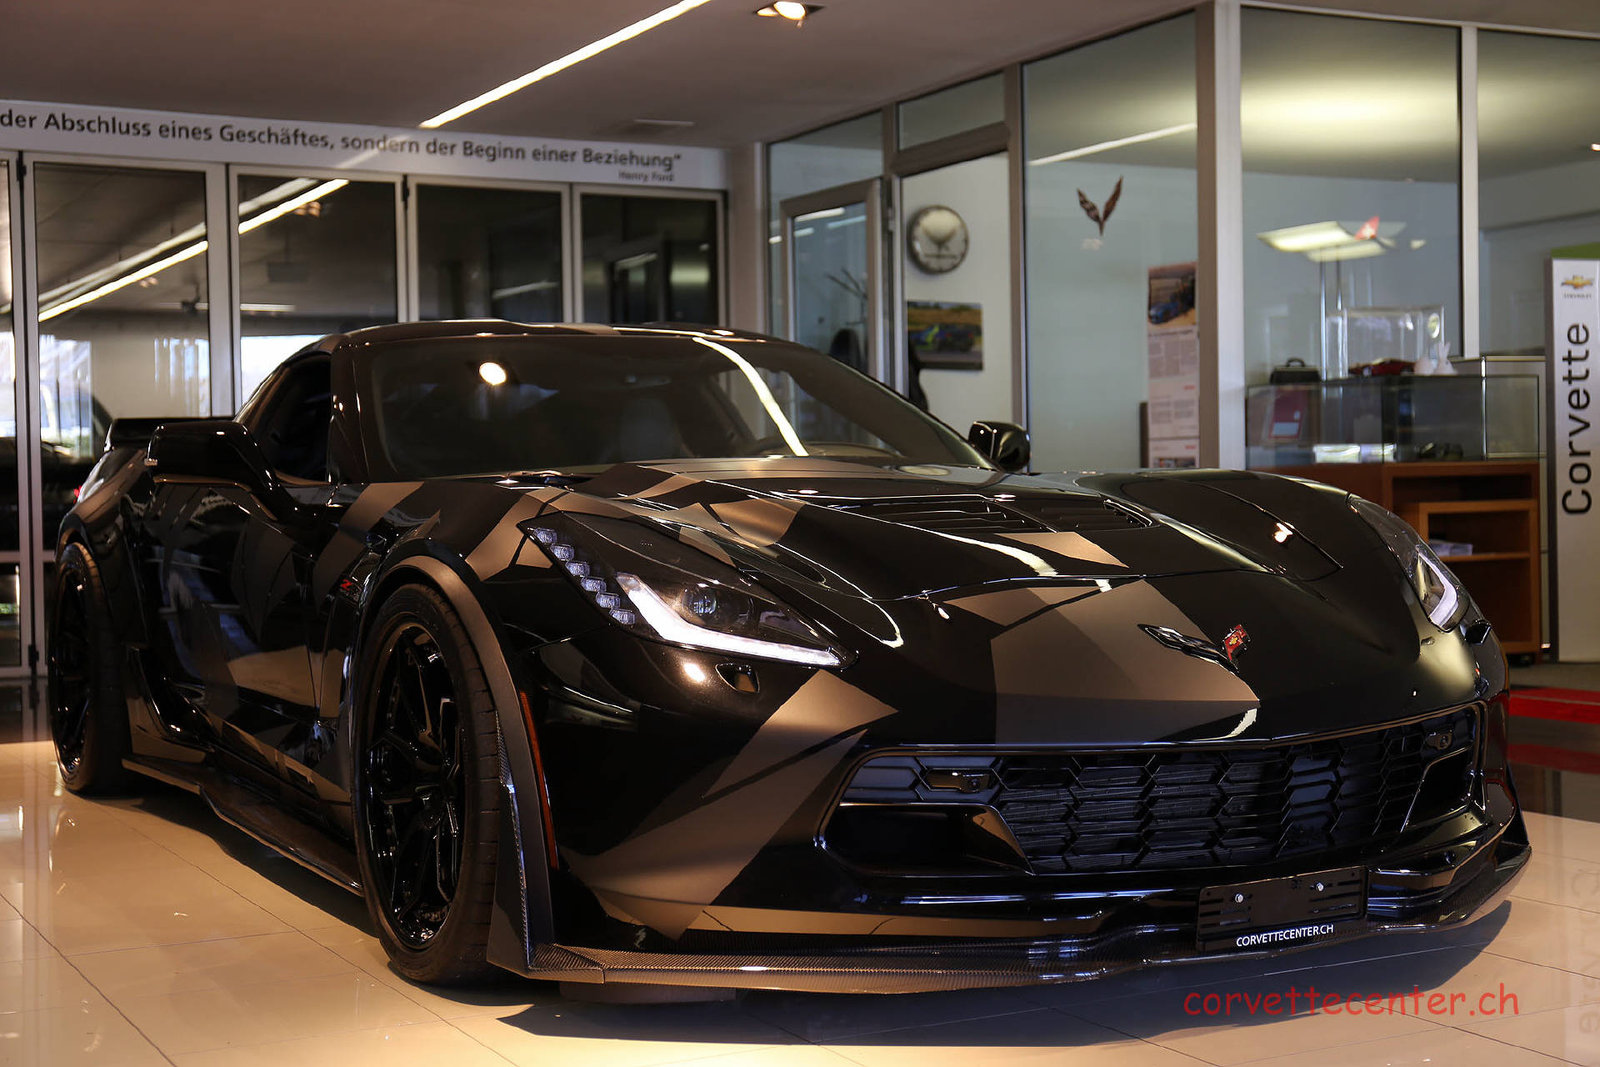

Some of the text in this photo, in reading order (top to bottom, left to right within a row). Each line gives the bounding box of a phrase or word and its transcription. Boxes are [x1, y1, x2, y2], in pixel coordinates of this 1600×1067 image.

[0, 109, 37, 128] der
[44, 112, 151, 137] Abschluss
[158, 120, 212, 141] eines
[219, 124, 335, 150] Geschäftes,
[341, 134, 420, 154] sondern
[425, 138, 457, 156] der
[462, 140, 526, 162] Beginn
[532, 145, 577, 162] einer
[1561, 323, 1592, 515] Corvette
[1236, 924, 1334, 947] CORVETTECENTER.CH
